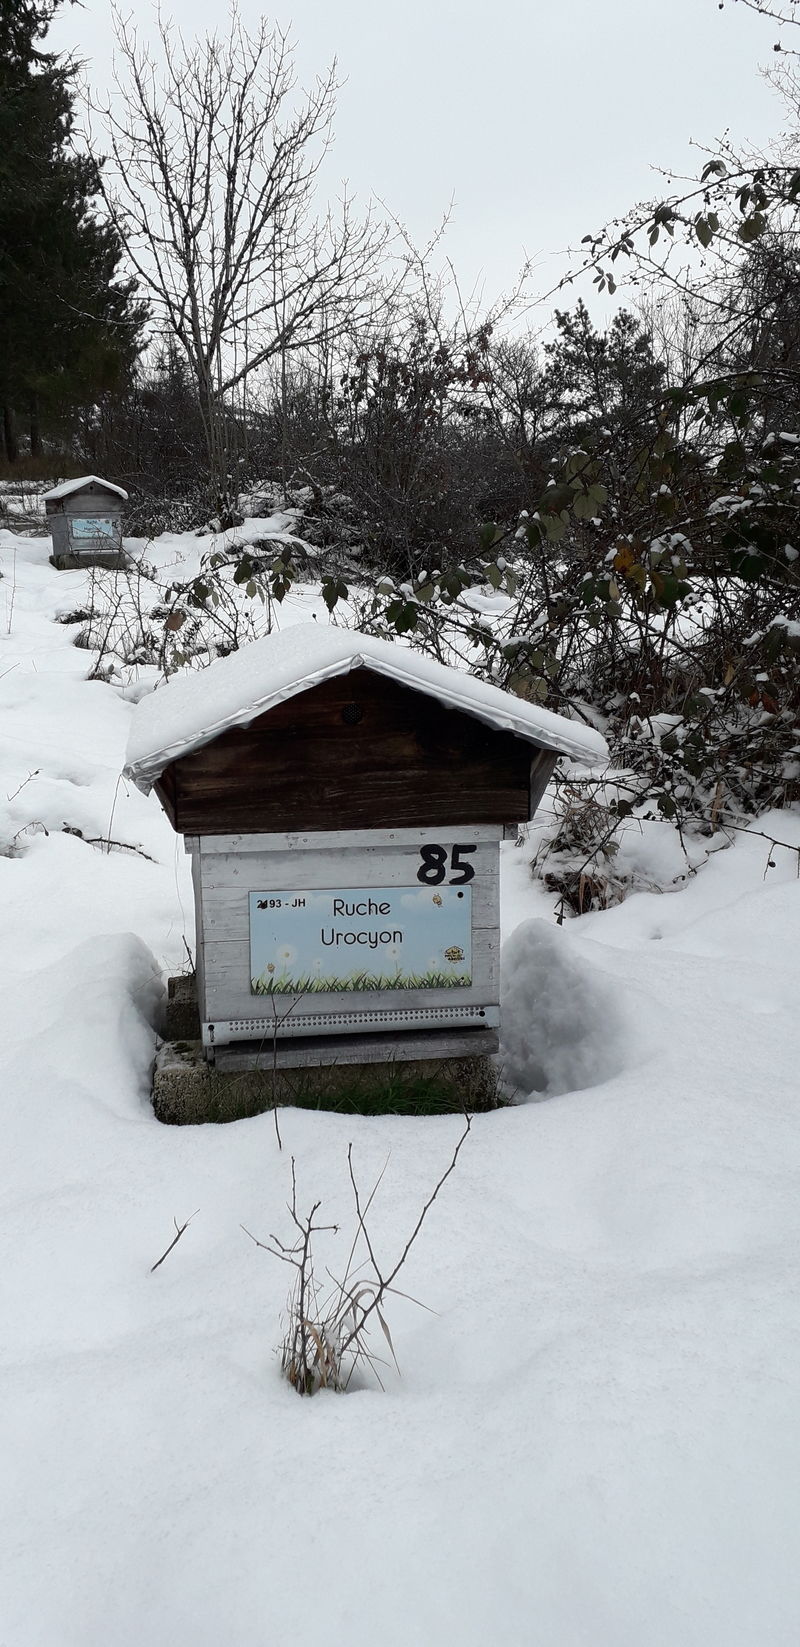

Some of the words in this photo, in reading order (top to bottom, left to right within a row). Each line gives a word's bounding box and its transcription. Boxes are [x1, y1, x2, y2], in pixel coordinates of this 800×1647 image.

[417, 844, 477, 885] 85
[291, 898, 306, 908] JH
[332, 898, 391, 916] Ruche
[320, 928, 403, 949] Urocyon
